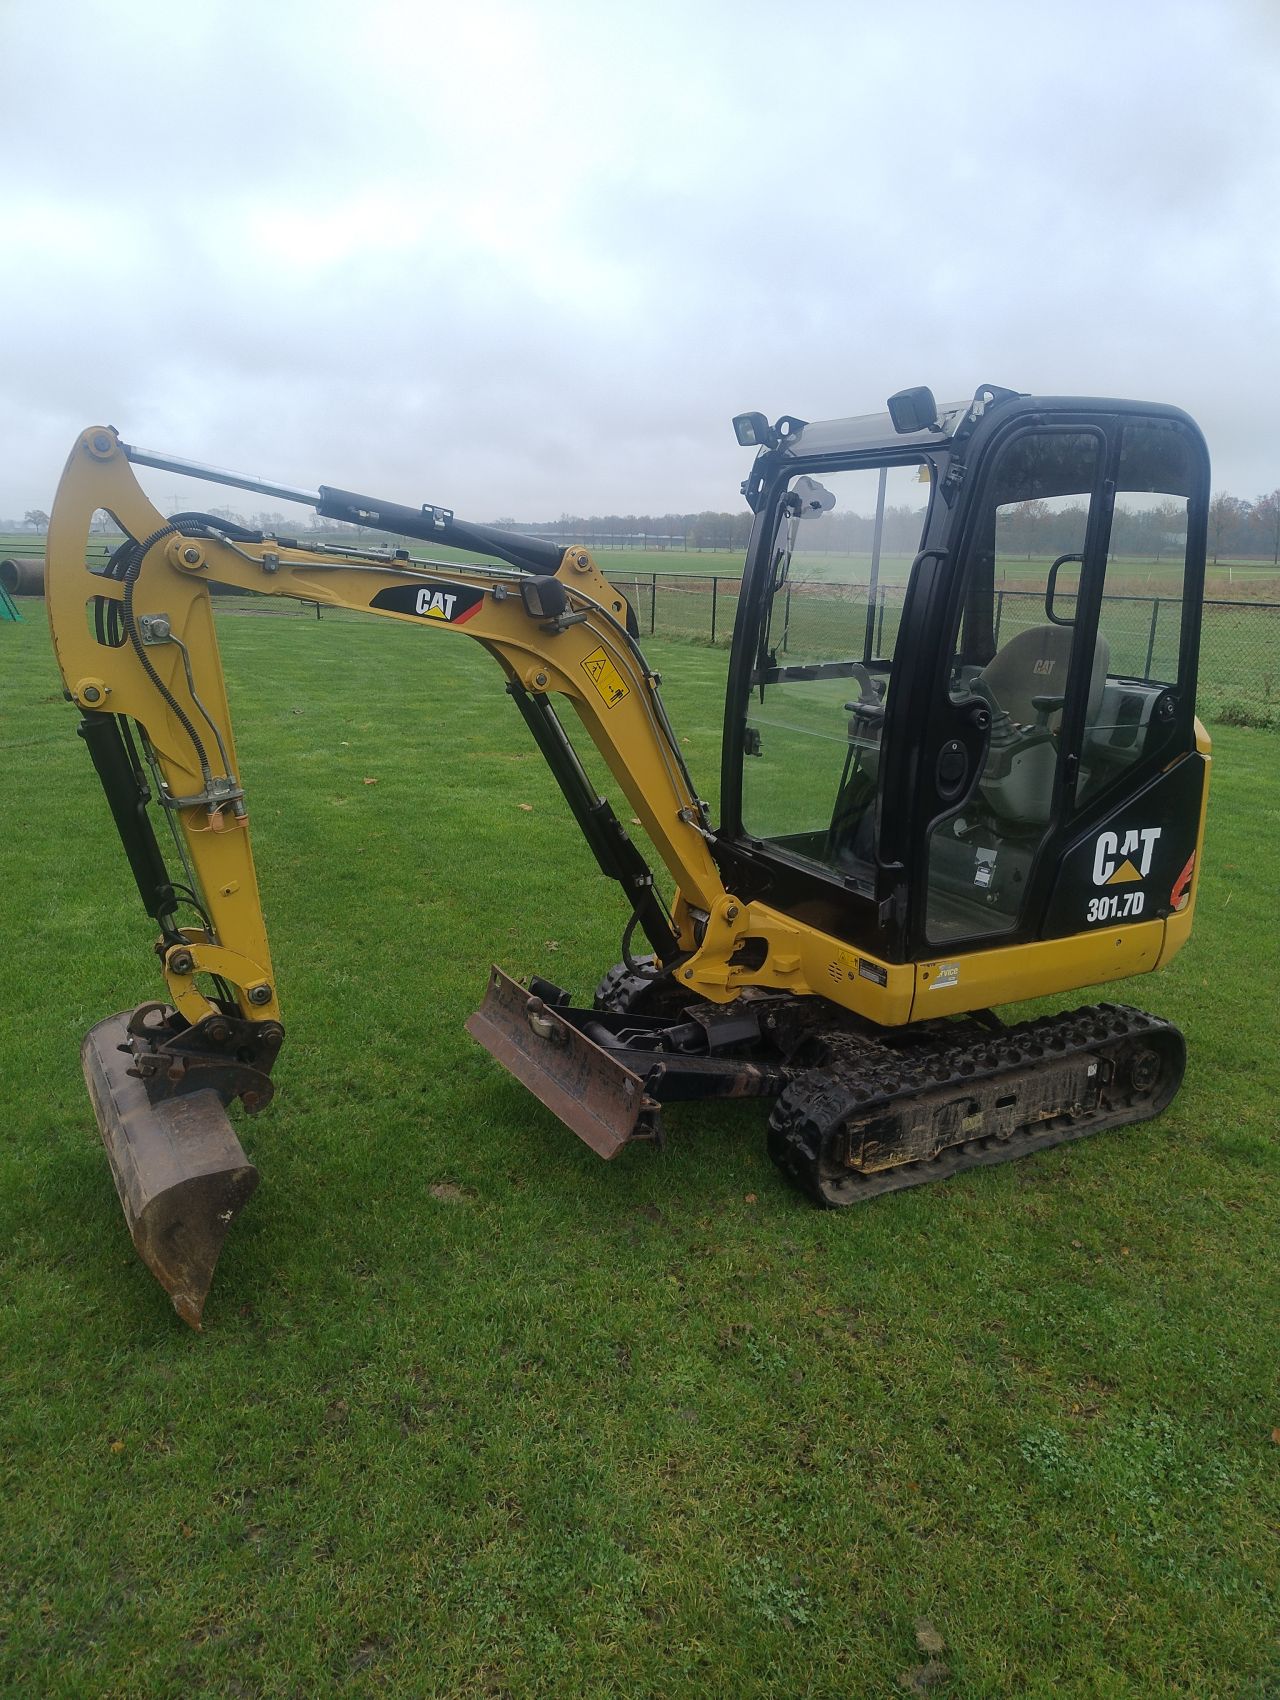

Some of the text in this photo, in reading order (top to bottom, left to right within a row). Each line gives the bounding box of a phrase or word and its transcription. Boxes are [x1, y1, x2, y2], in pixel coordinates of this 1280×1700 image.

[415, 588, 457, 620] CAT
[1033, 659, 1056, 675] CAT
[1092, 827, 1162, 886] CAT
[1086, 891, 1145, 922] 301.7D
